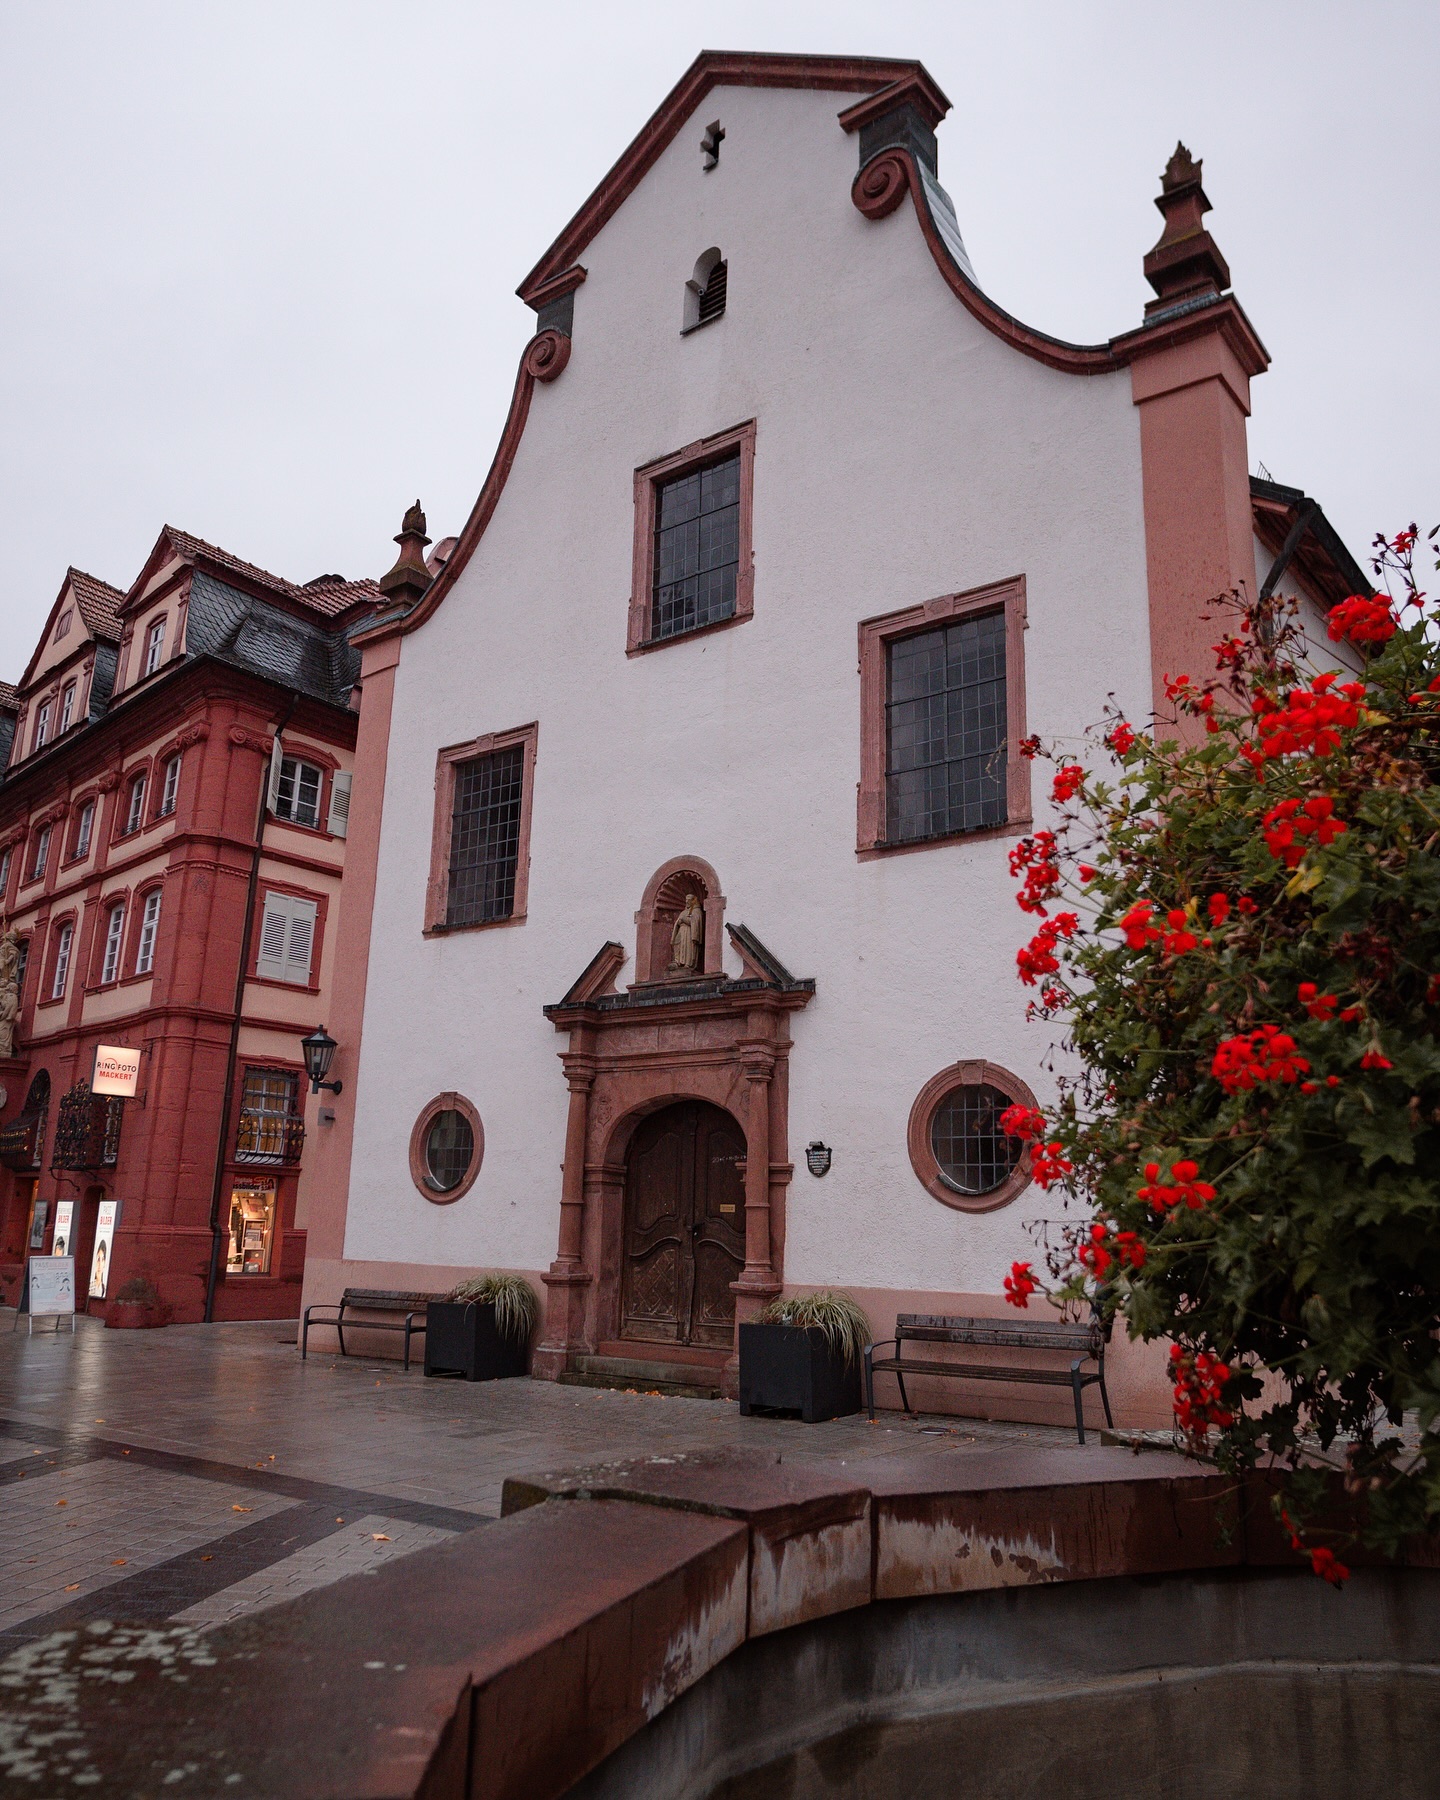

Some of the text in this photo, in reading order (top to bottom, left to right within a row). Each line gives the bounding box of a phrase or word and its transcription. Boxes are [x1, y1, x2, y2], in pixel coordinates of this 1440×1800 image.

[118, 1064, 136, 1072] FOTO
[99, 1071, 132, 1080] MACKERT
[58, 1215, 69, 1223] BILDER
[100, 1216, 112, 1225] BILDER
